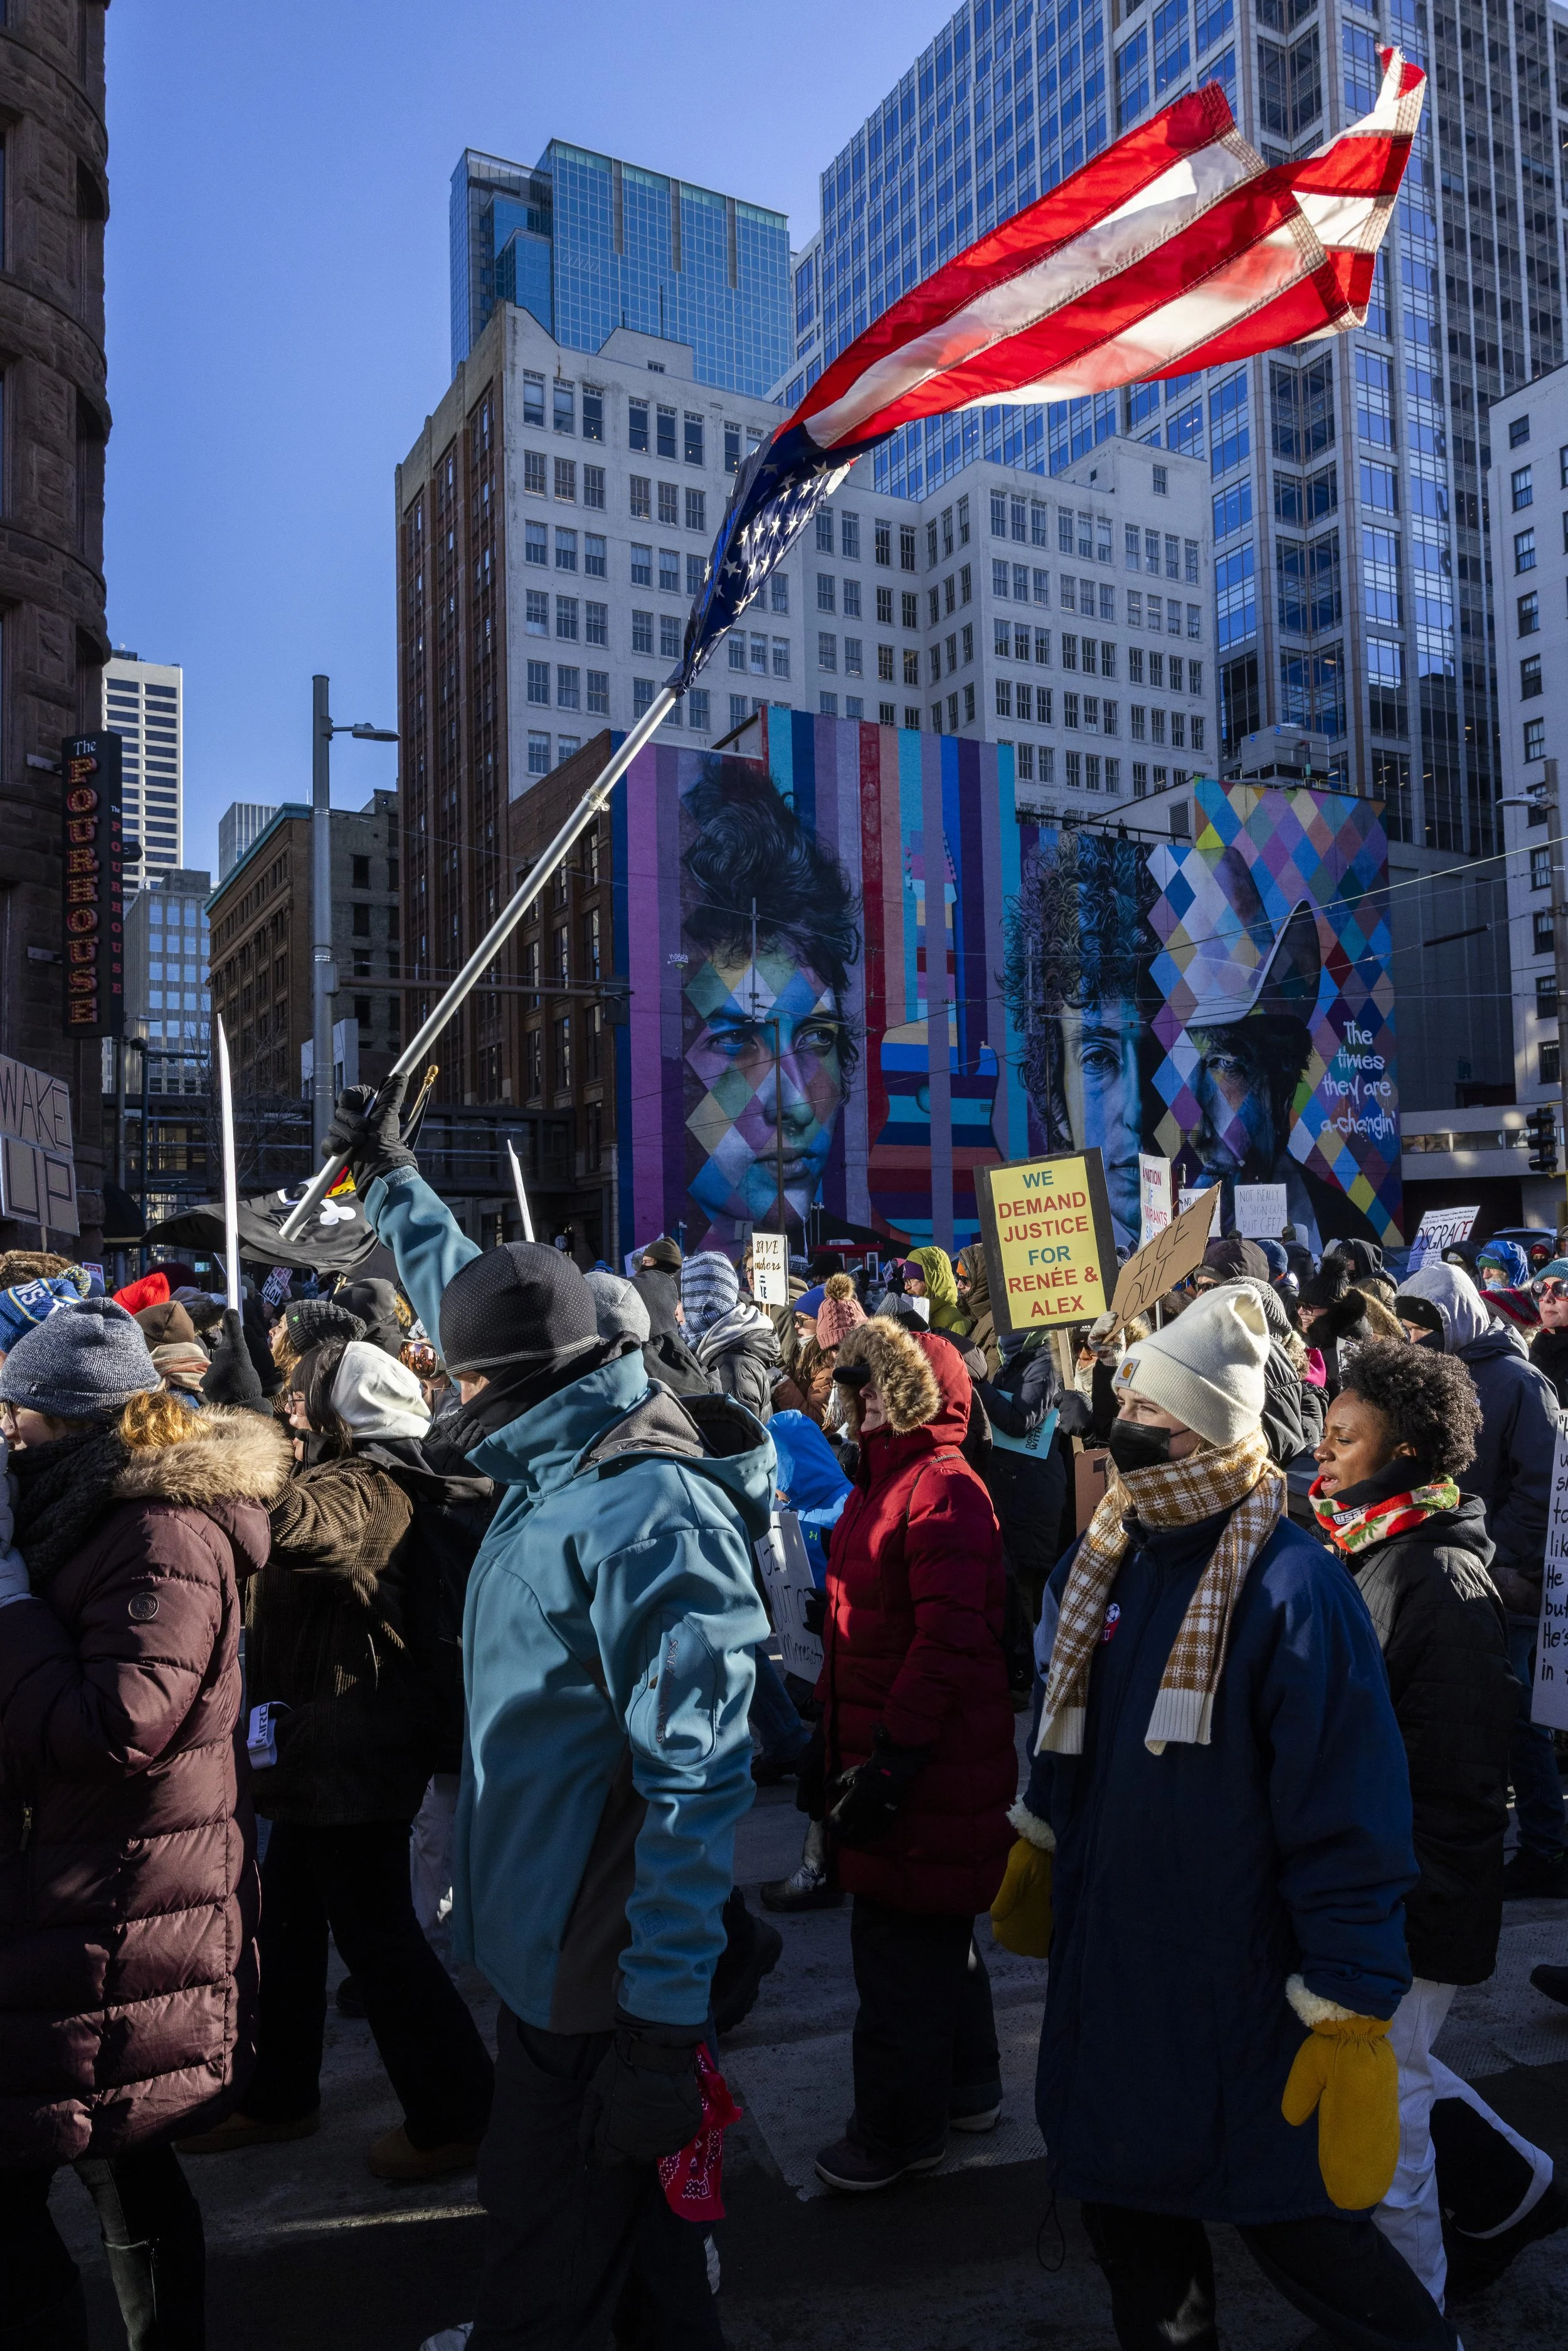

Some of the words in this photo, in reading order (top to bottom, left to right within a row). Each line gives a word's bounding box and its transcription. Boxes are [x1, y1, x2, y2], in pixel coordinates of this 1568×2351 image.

[73, 740, 97, 756] The
[111, 805, 120, 814] The
[66, 756, 100, 1024] POURHOUSE
[111, 820, 121, 994] POURHOUSE
[1343, 1020, 1373, 1046] The
[1337, 1046, 1385, 1070] times
[1322, 1072, 1360, 1105] they
[1364, 1081, 1392, 1097] are
[0, 1062, 72, 1150] WAKE
[5, 1136, 73, 1226] UP
[1022, 1170, 1054, 1189] WE
[998, 1191, 1087, 1219] DEMAND
[1239, 1189, 1254, 1203] NOT
[1257, 1189, 1279, 1202] REALLY
[1239, 1206, 1244, 1216] A
[1249, 1204, 1267, 1216] SIGN
[1004, 1216, 1089, 1243] JUSTICE
[1242, 1219, 1258, 1233] BUT
[1411, 1220, 1473, 1252] DISGRACE
[1028, 1245, 1072, 1266] FOR
[1132, 1205, 1196, 1282] ICE
[1008, 1266, 1078, 1294] RENÉE
[1084, 1266, 1099, 1283] &
[1122, 1250, 1175, 1321] OUT
[1030, 1295, 1085, 1318] ALEX
[1030, 1427, 1042, 1450] WITH
[1547, 1563, 1564, 1589] He
[770, 1584, 795, 1632] OUT
[1541, 1657, 1554, 1681] in
